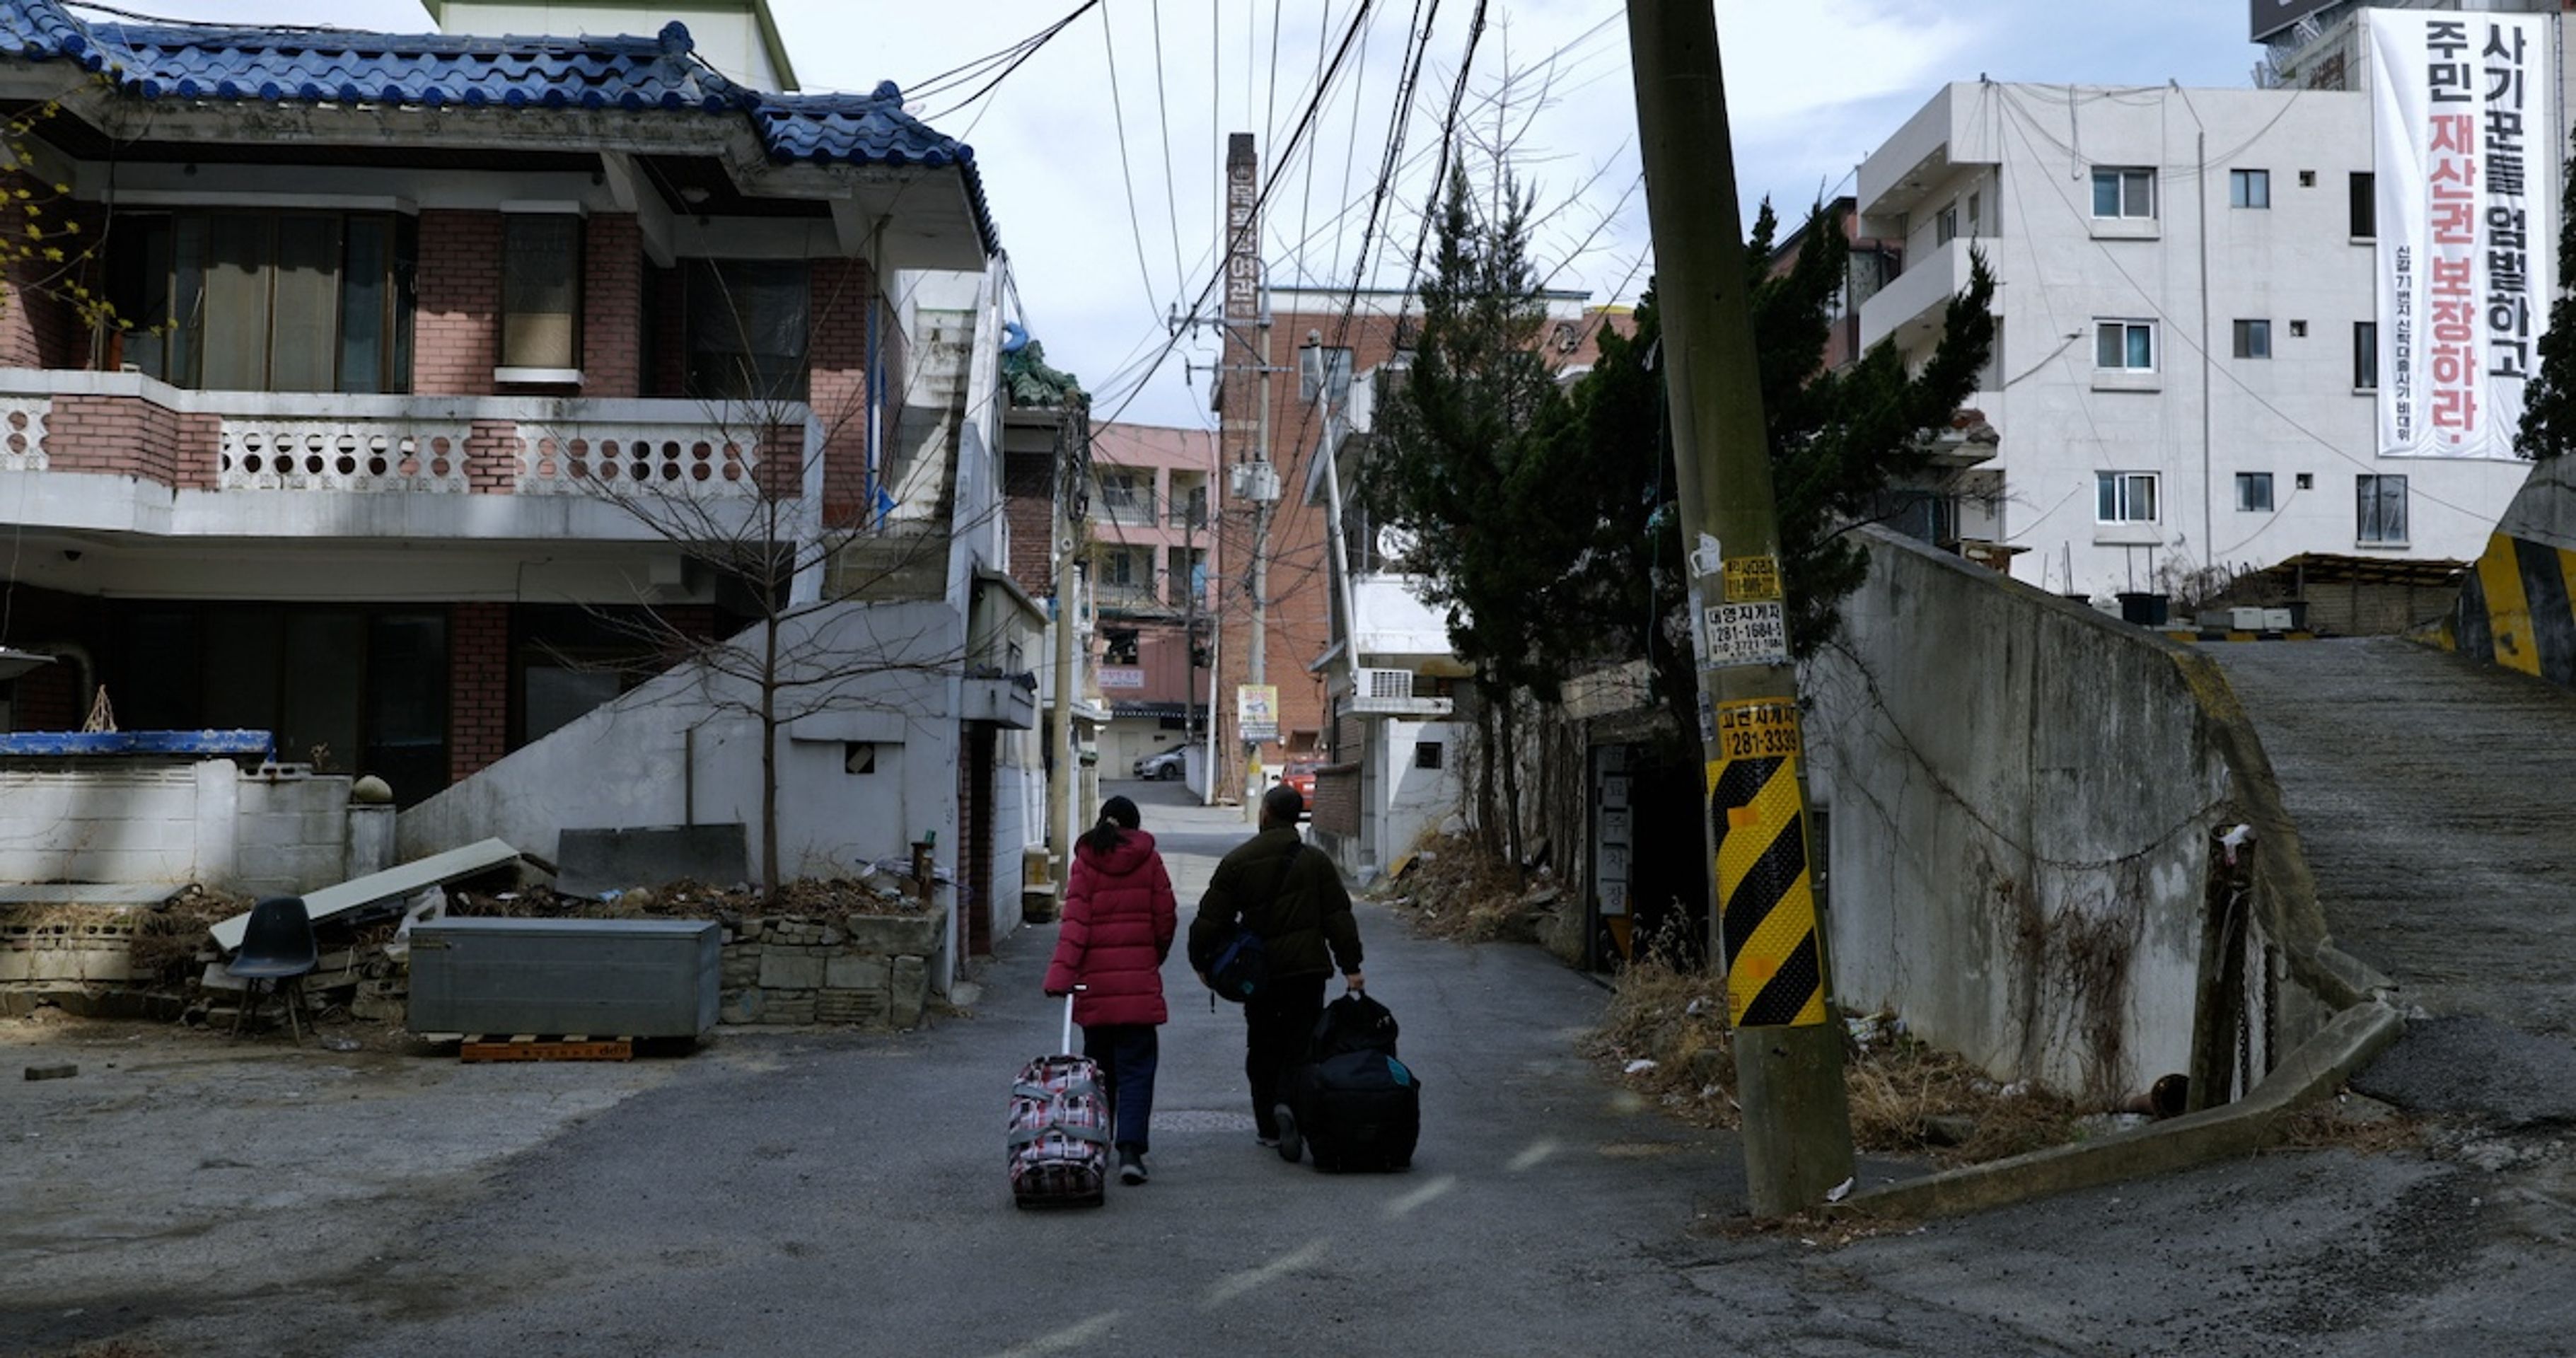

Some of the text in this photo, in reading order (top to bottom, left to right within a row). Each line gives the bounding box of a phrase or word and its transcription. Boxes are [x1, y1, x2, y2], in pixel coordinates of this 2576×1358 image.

[2482, 24, 2531, 380] 사기꾼들 엄벌하고
[2425, 21, 2478, 445] 주민 재산권 보장하라.
[2396, 401, 2410, 441] 비대위
[1708, 603, 1780, 624] 대영지게차
[1732, 729, 1797, 755] 281-3339
